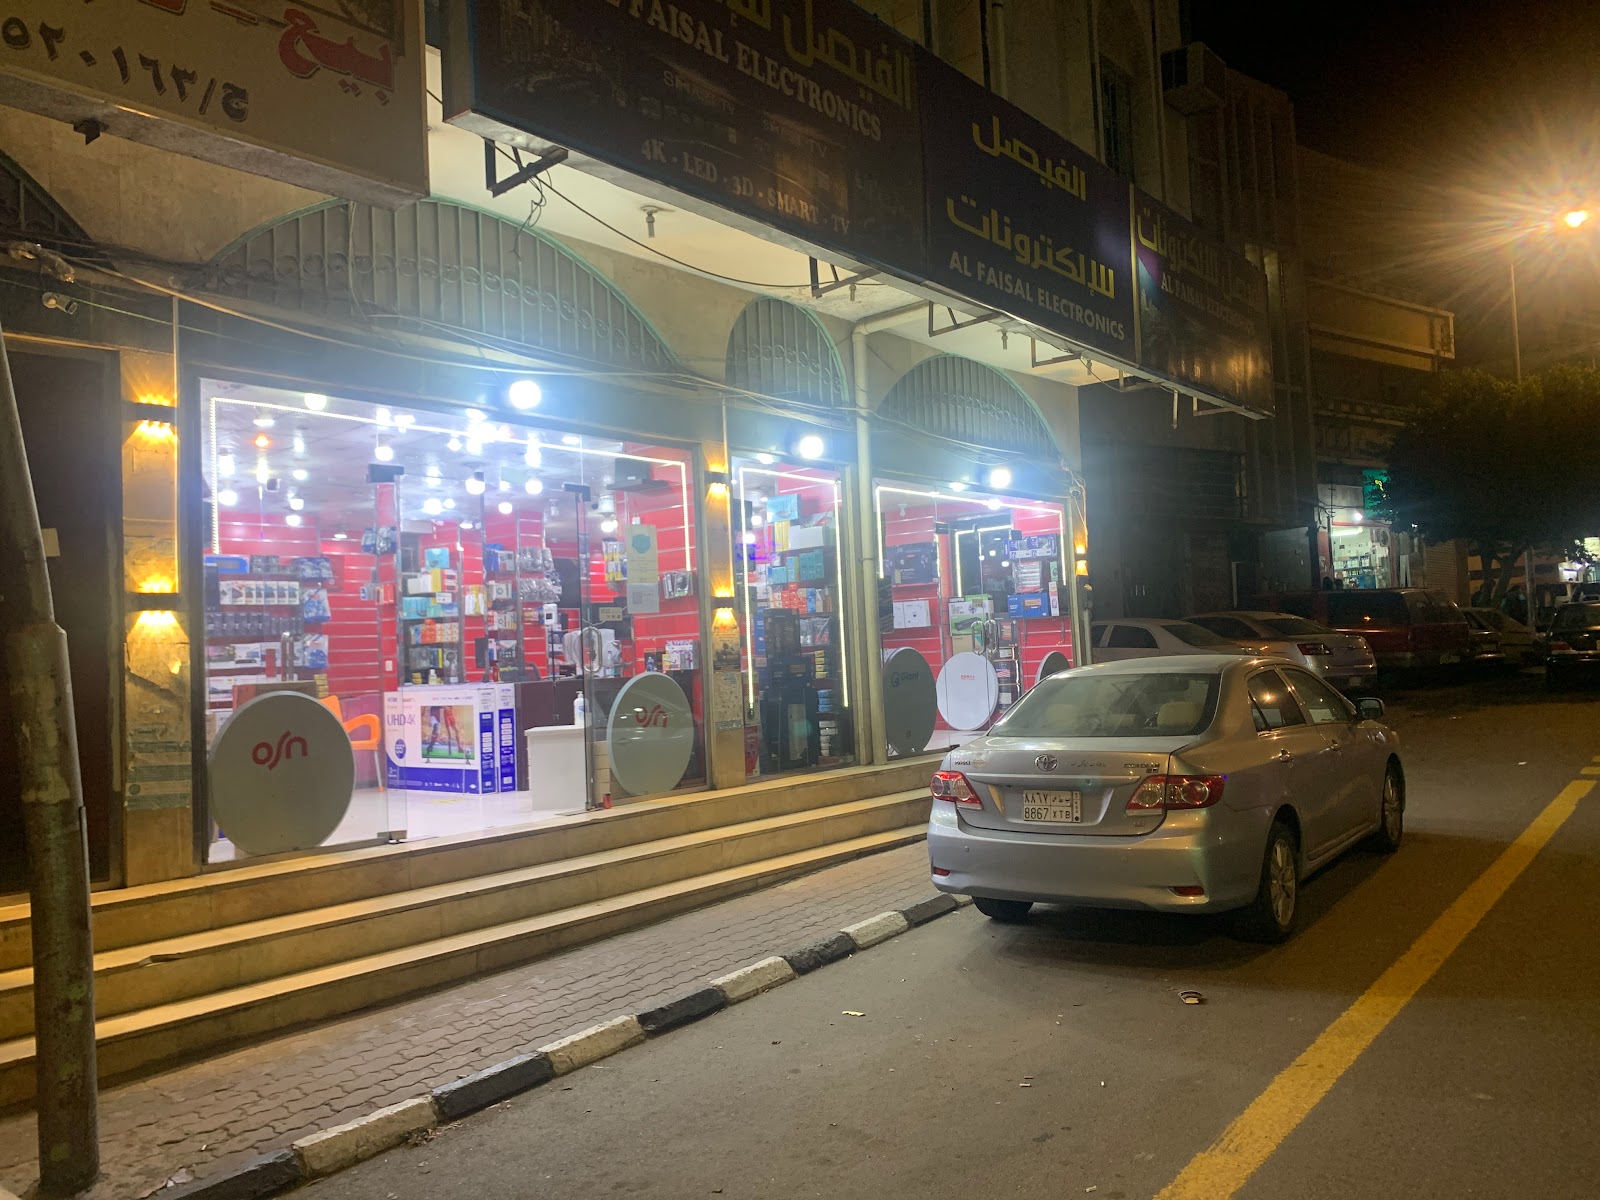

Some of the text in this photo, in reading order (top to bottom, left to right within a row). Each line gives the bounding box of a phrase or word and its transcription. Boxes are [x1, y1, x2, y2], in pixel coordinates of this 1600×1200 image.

[735, 40, 882, 142] ELECTRONICS
[782, 0, 910, 112] الفيصل
[641, 138, 850, 236] 4K LED 3D SMART TV
[971, 113, 1087, 202] الفيصل
[949, 250, 1125, 341] AL FAISAL ELECTRONICS
[1161, 271, 1174, 294] AL
[387, 713, 406, 726] UHD
[1024, 807, 1049, 820] 8867
